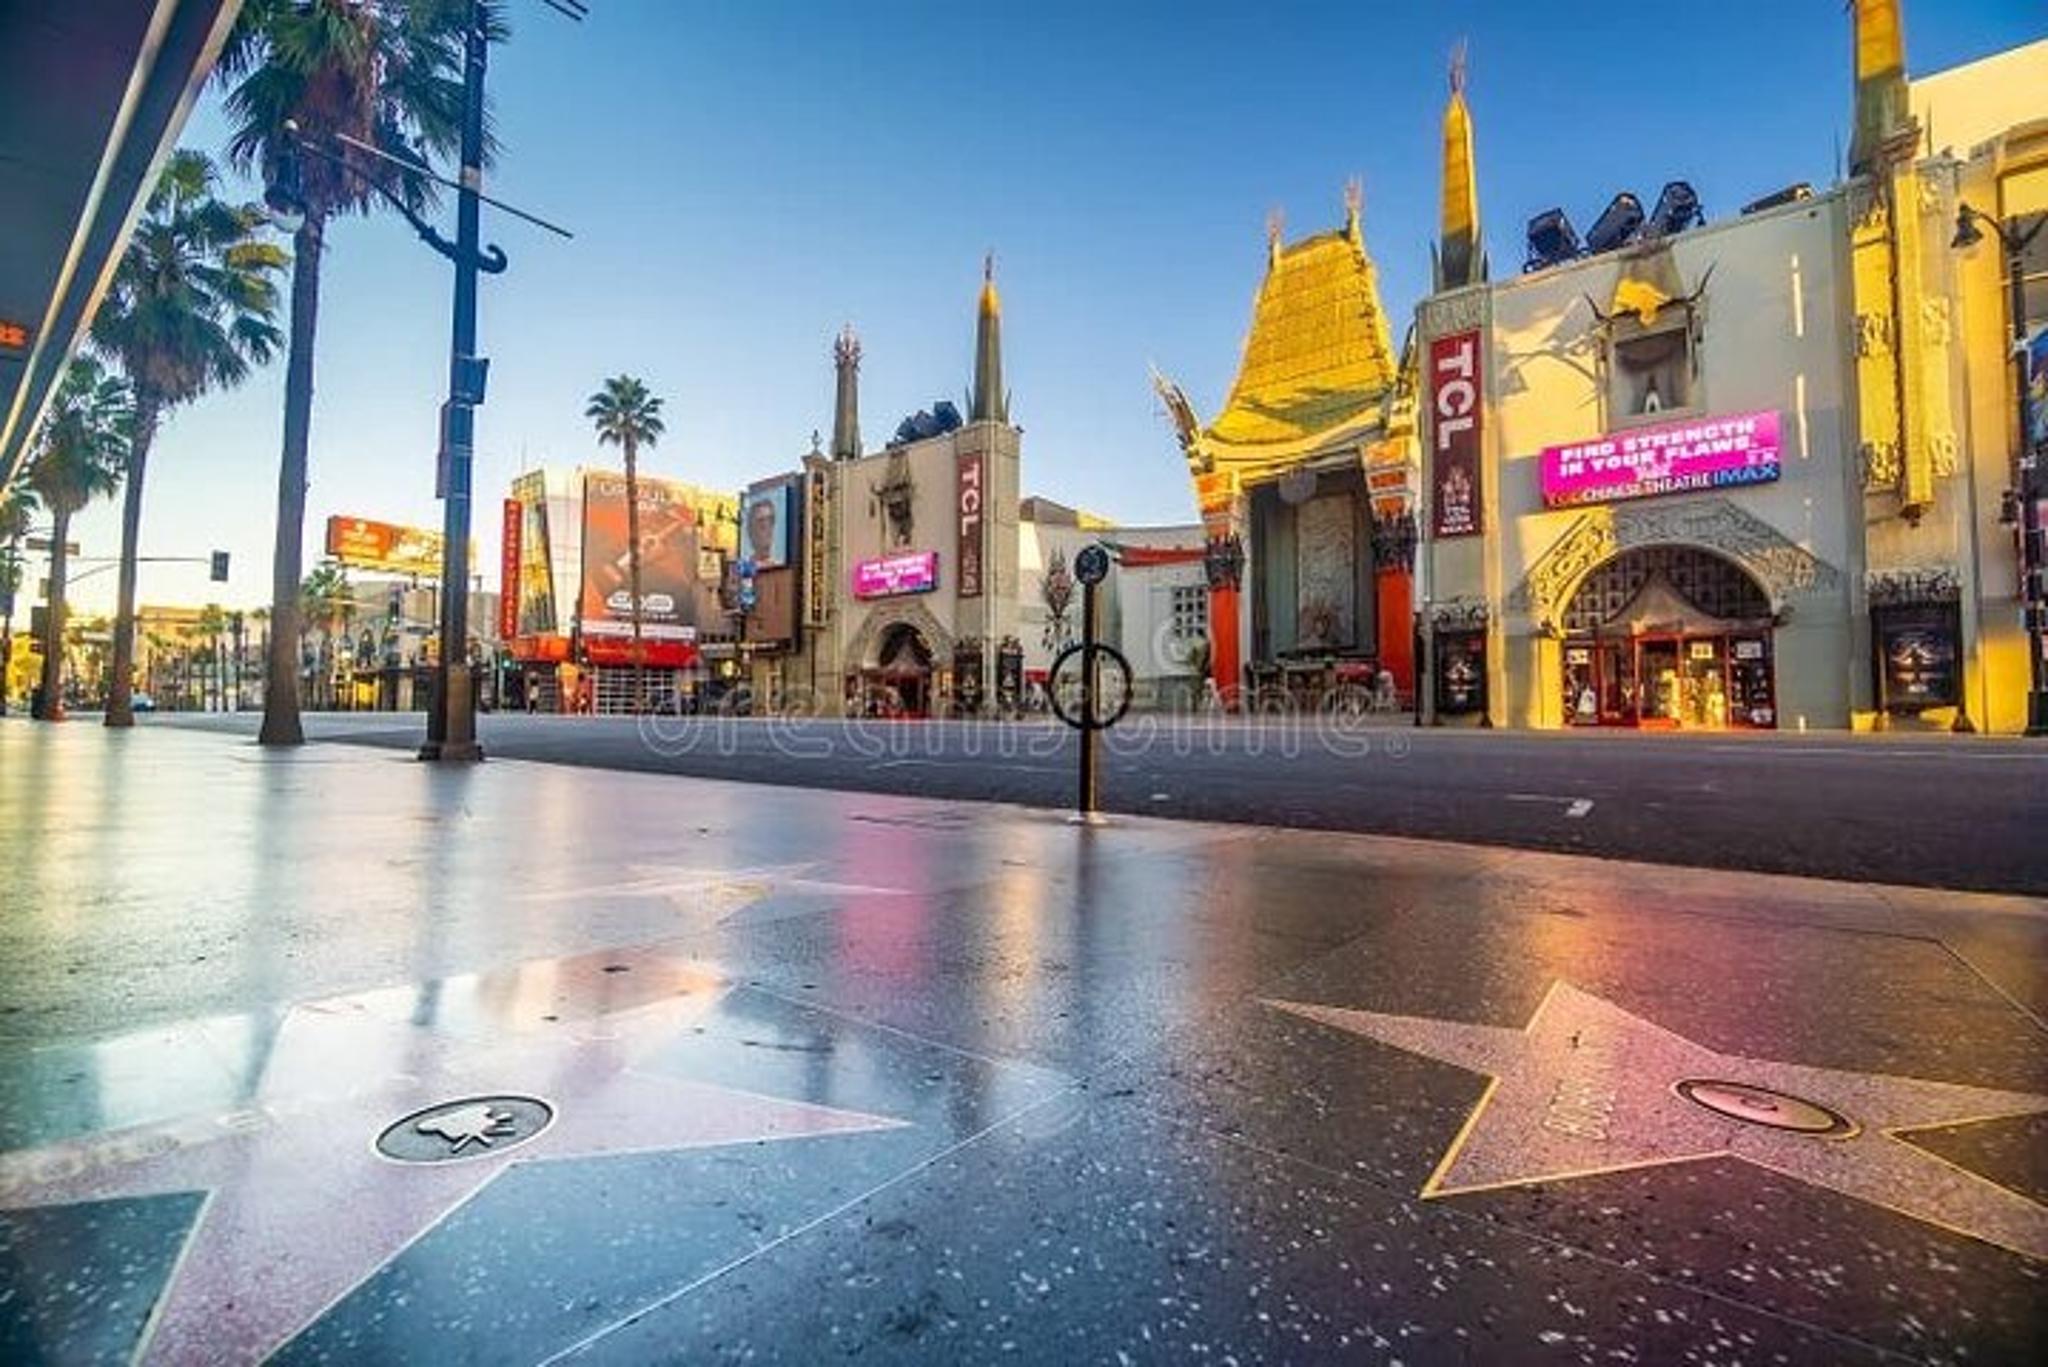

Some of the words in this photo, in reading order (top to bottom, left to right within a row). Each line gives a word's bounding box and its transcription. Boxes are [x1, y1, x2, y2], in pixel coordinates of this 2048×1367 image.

[1437, 341, 1476, 450] TCL
[1622, 418, 1755, 453] STRENGTH
[1560, 460, 1584, 479] IN
[1591, 450, 1656, 474] YOUR
[1643, 472, 1712, 497] THEATRE
[1714, 461, 1778, 485] IMAX
[962, 461, 979, 537] TCL
